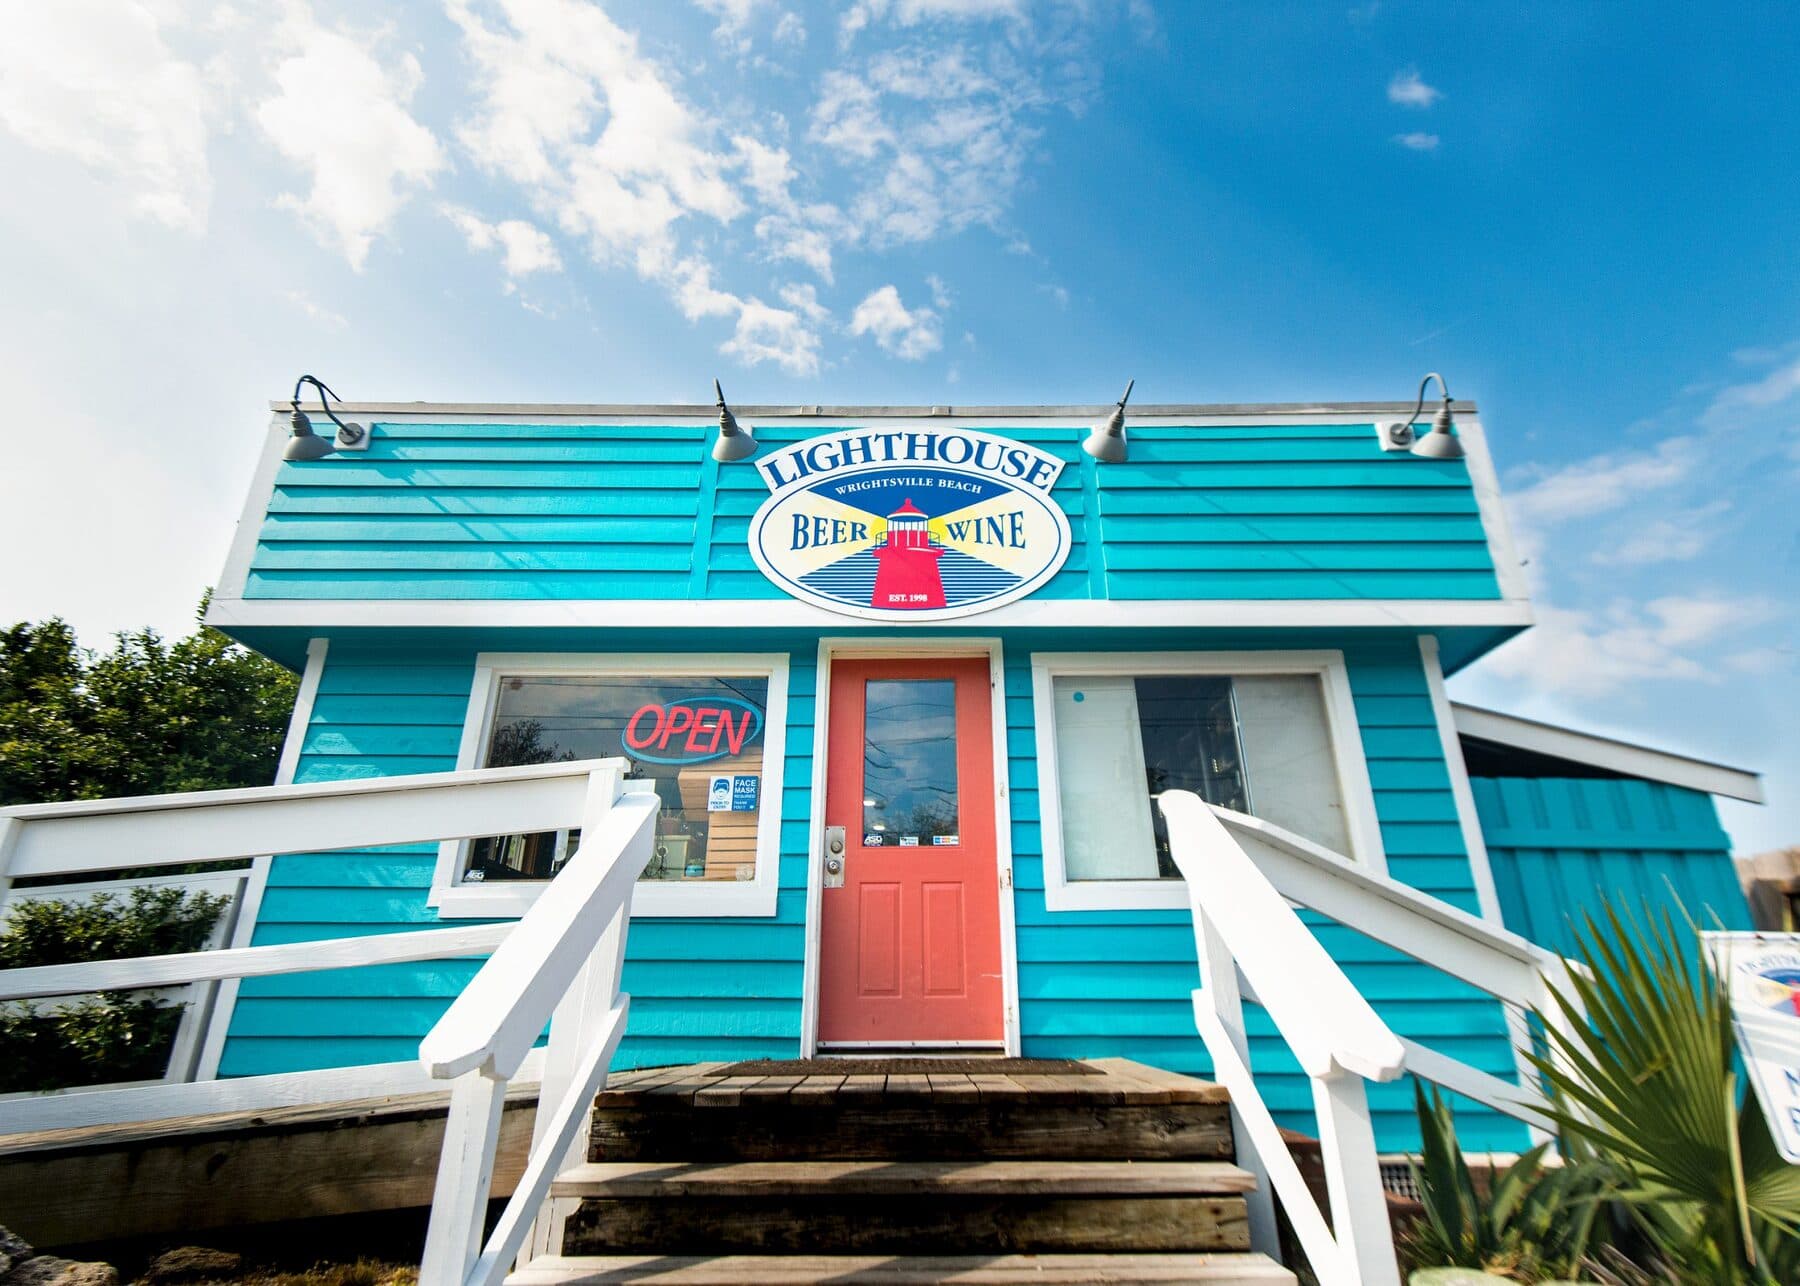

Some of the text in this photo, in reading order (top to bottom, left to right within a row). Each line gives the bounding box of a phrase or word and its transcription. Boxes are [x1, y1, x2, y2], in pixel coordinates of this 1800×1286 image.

[763, 432, 1056, 489] LIGHTHOUSE
[835, 477, 982, 495] WRIGHTSVILLE BEACH
[790, 510, 1026, 550] BEER WINE
[888, 594, 907, 602] EST.
[625, 704, 751, 755] OPEN
[735, 779, 757, 787] FACE
